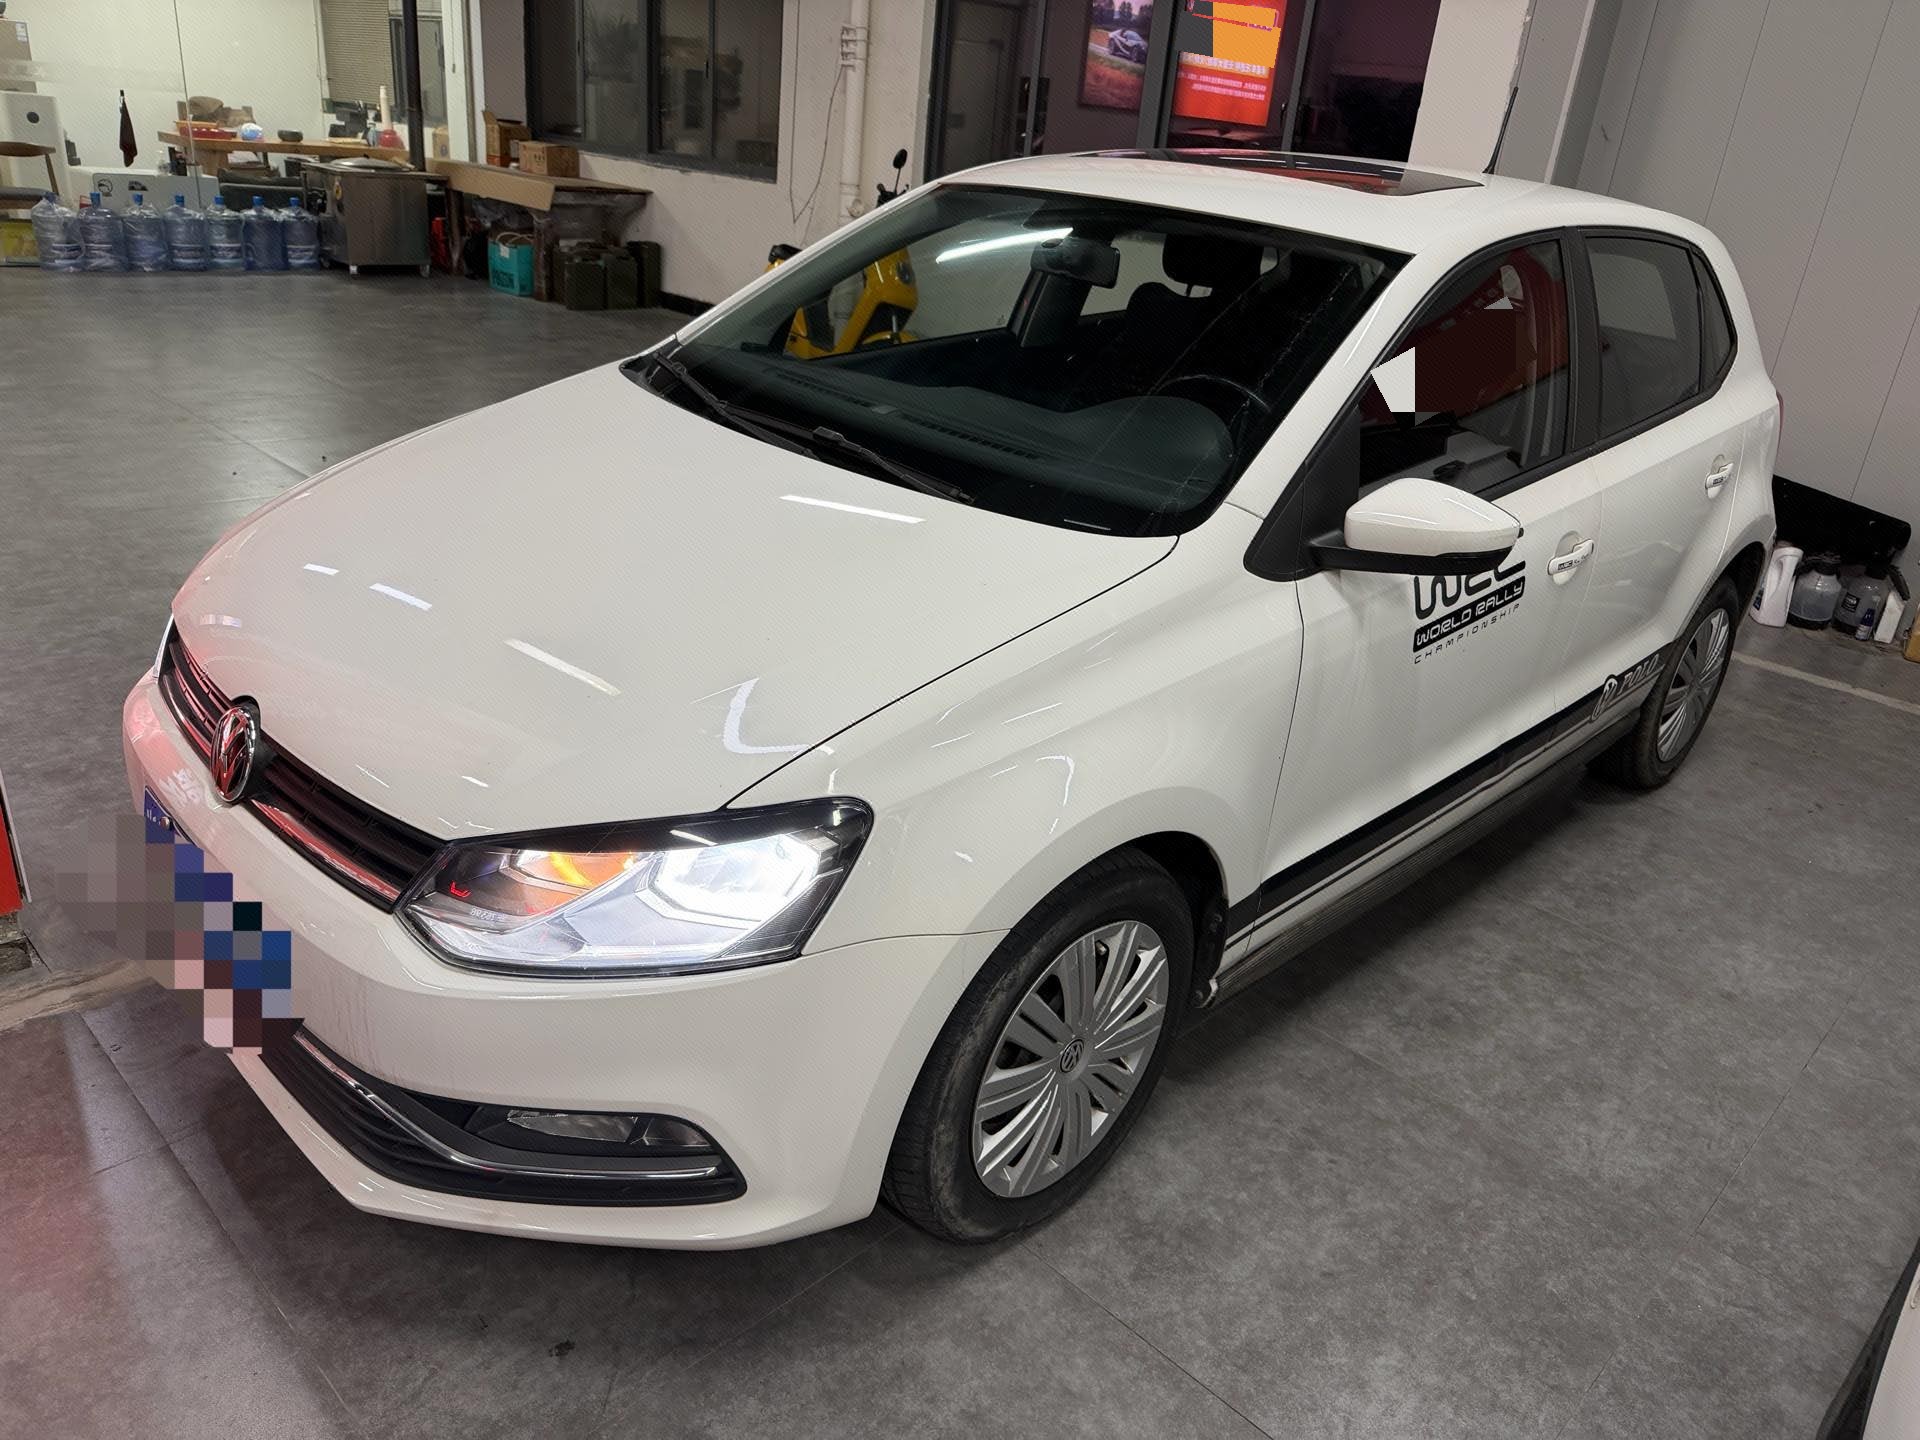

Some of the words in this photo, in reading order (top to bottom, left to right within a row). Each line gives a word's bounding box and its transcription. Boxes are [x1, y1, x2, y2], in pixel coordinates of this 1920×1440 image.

[1414, 603, 1520, 665] CHAMPIONSHIP
[1416, 608, 1472, 646] WORLD
[1475, 580, 1524, 617] RALLY
